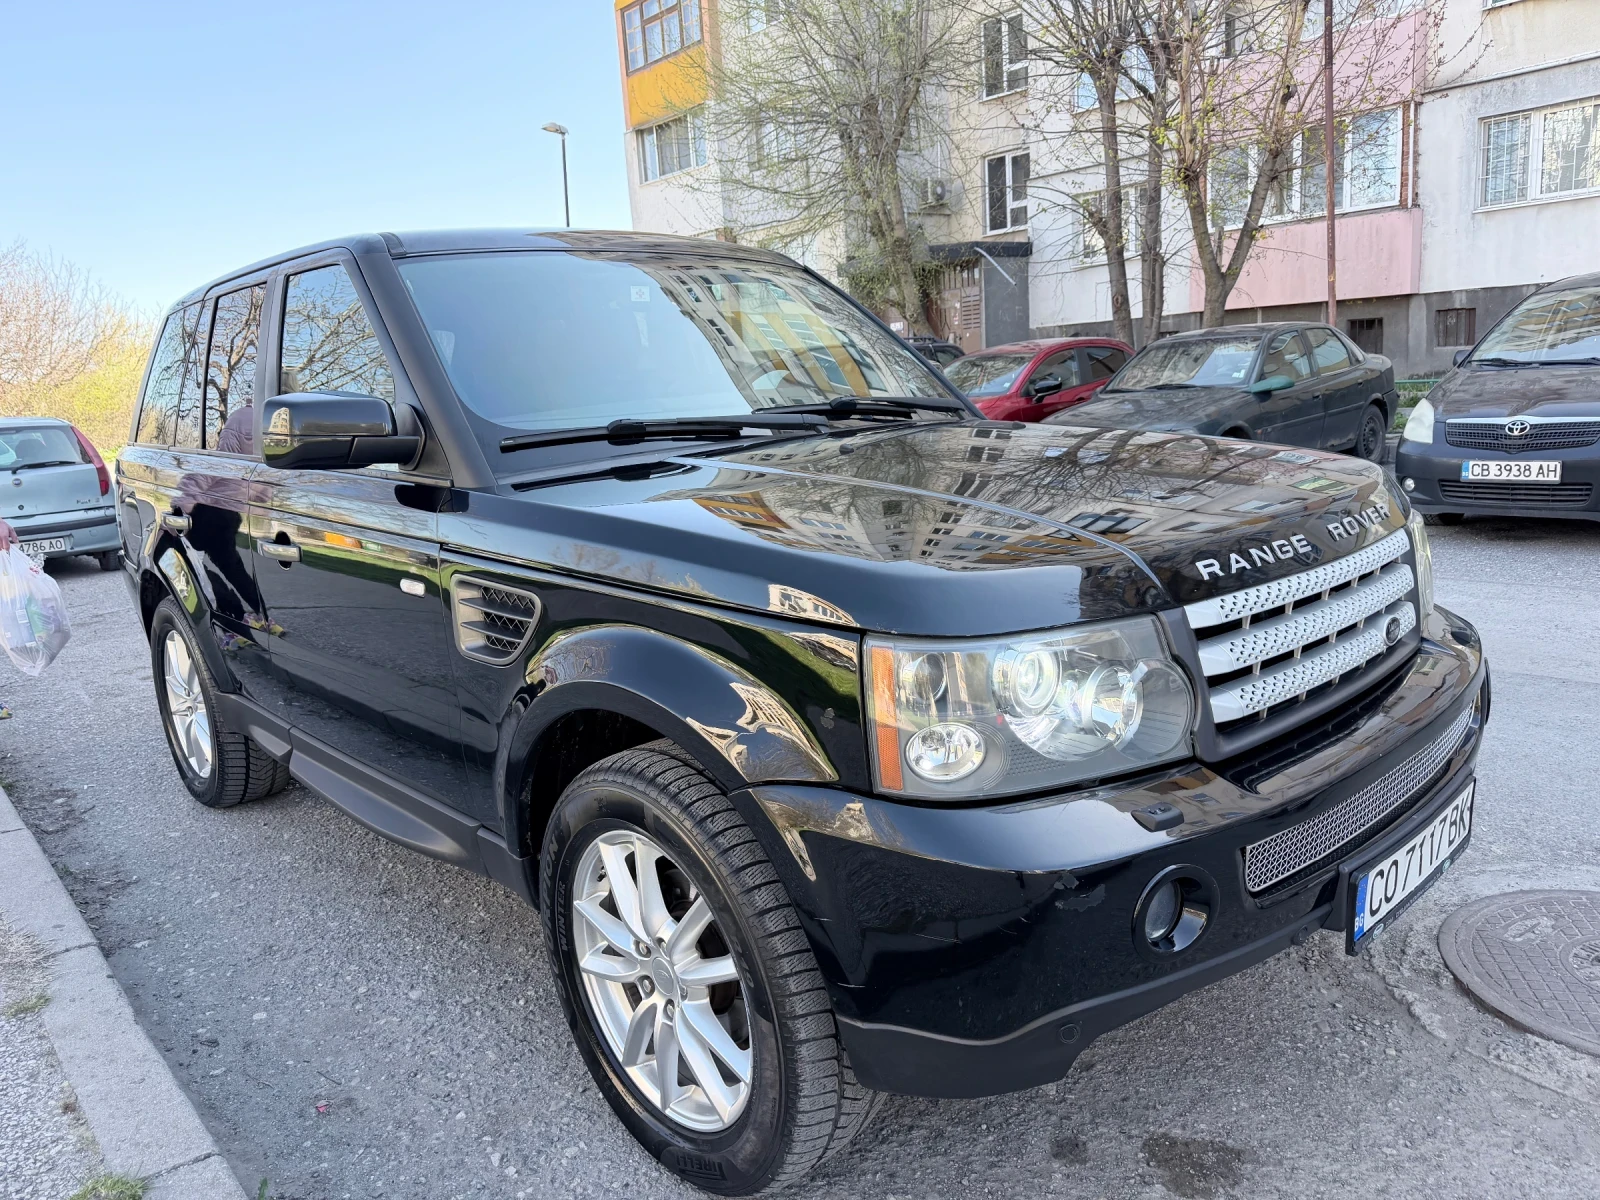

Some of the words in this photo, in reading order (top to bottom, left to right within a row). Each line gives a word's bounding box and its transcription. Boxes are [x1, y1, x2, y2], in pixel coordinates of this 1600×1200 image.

[1471, 463, 1490, 477] CB
[1493, 463, 1532, 478] 3938
[1535, 463, 1558, 478] AH
[1195, 533, 1312, 581] RANGE
[1325, 502, 1391, 542] ROVER
[1401, 813, 1448, 892] 7117
[541, 833, 566, 999] SCORPION
[557, 881, 568, 951] WINTER
[1355, 913, 1365, 932] BG
[676, 1152, 728, 1181] PIRELLI
